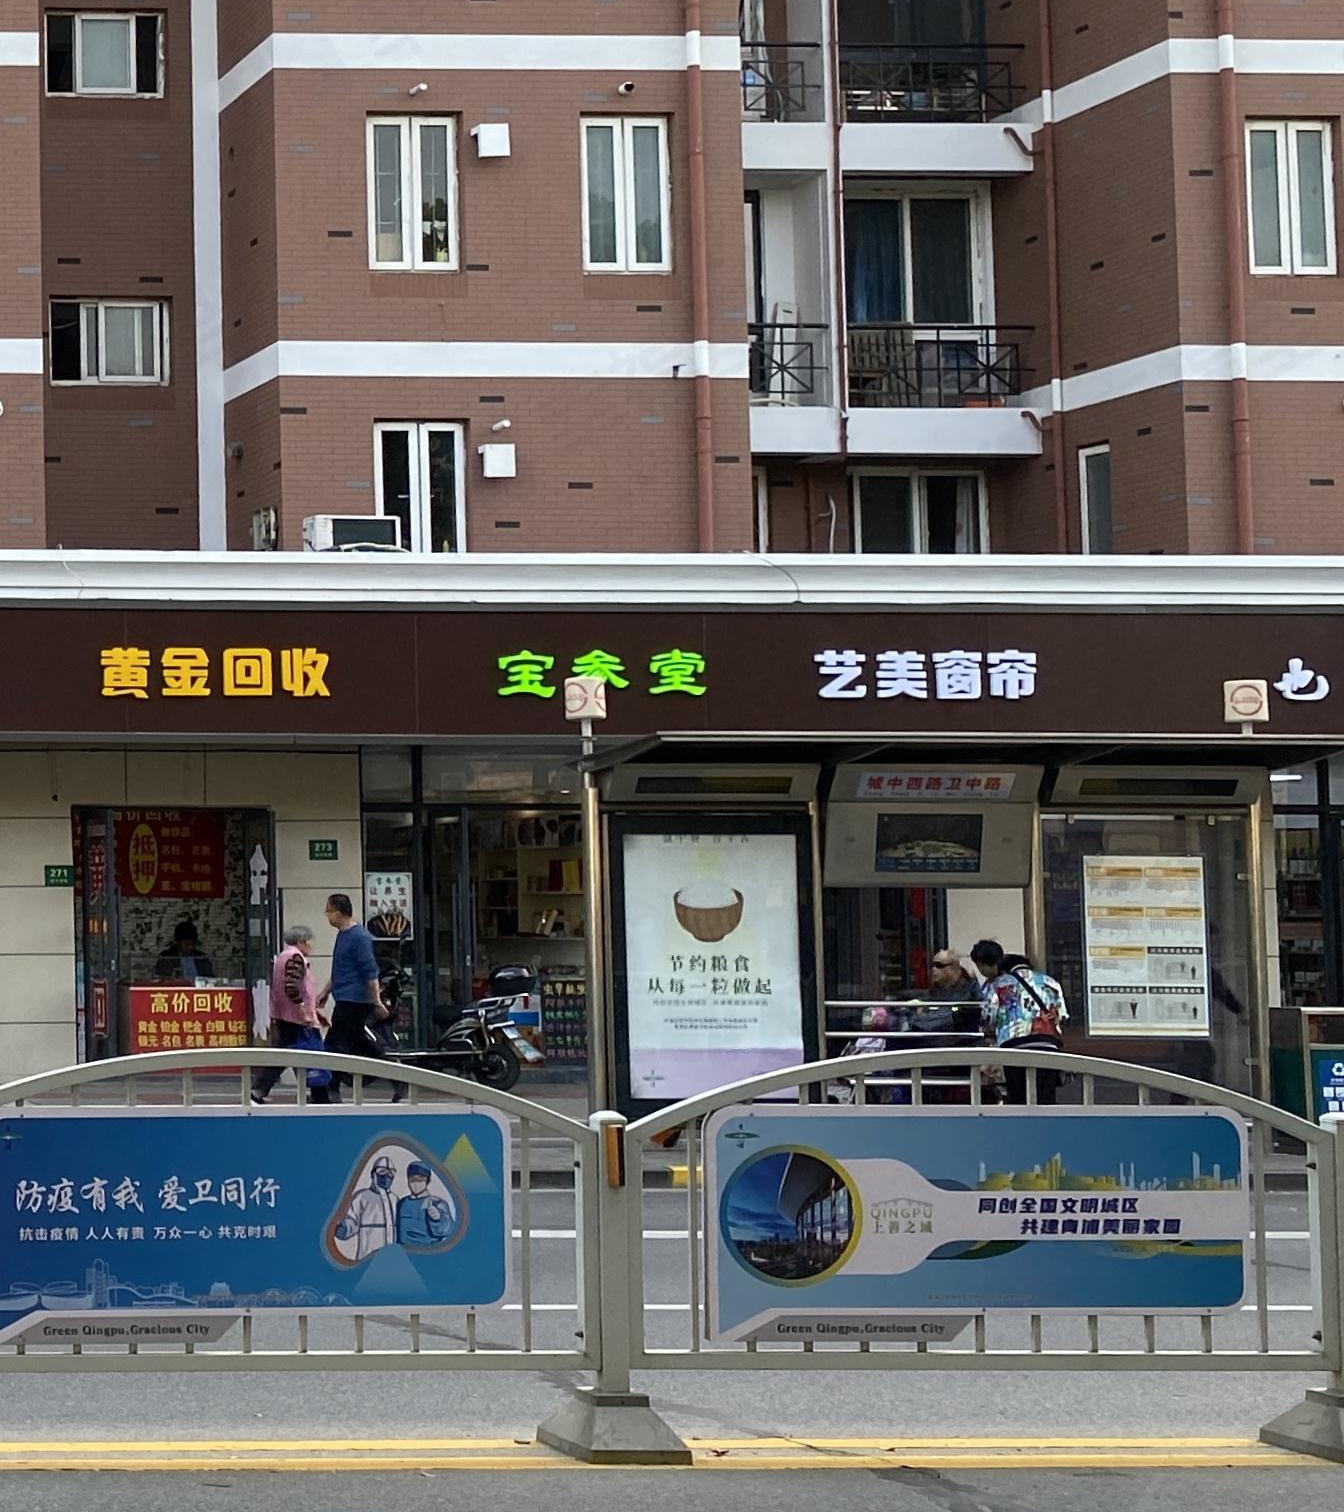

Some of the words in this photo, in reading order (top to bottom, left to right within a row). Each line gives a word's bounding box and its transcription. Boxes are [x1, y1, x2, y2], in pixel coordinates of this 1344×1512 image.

[100, 646, 331, 699] 黄金回收
[814, 649, 1038, 700] 艺美窗帘
[314, 843, 333, 851] 273
[50, 869, 68, 878] 271
[671, 954, 750, 973] 节约粮食
[647, 977, 772, 996] 从每一粒做起
[150, 992, 233, 1013] 高价回收
[16, 1176, 145, 1214] 防疫有我
[158, 1175, 280, 1211] 爱卫同行
[870, 1208, 933, 1219] QINGPU
[978, 1197, 1139, 1214] 同创全国文明城区
[19, 1227, 79, 1240] 抗击疫情
[86, 1227, 145, 1240] 人人有责
[153, 1226, 212, 1239] 万众一心
[218, 1225, 277, 1239] 共克时艰
[871, 1220, 933, 1234] 上善之城
[1020, 1219, 1182, 1235] 共建青浦美丽家园
[43, 1326, 78, 1336] Green
[186, 1323, 210, 1335] City
[777, 1323, 812, 1333] Green
[921, 1322, 945, 1334] City
